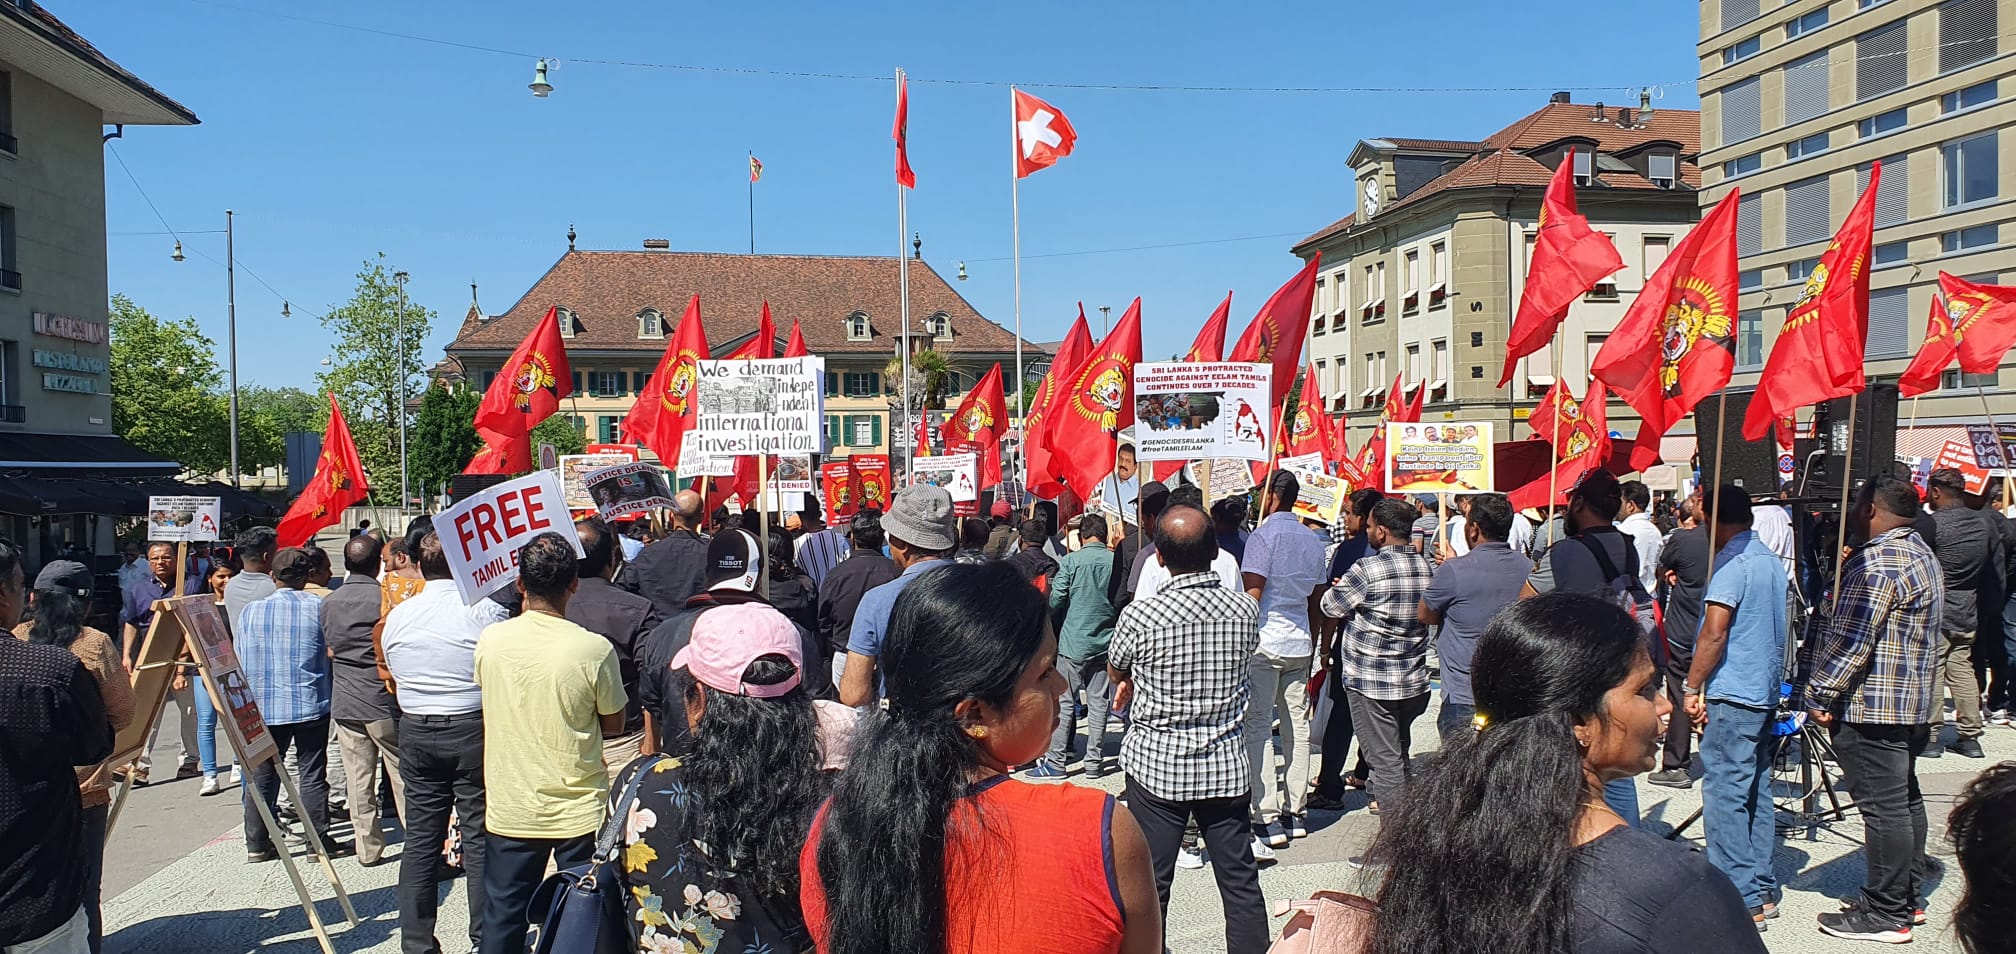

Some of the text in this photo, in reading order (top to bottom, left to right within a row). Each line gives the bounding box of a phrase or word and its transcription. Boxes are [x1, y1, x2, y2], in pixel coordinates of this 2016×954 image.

[698, 358, 804, 378] We demand
[699, 412, 808, 431] international
[698, 433, 815, 453] investigation.
[586, 468, 623, 487] JUSTICE
[617, 478, 632, 487] IS
[604, 503, 644, 520] JUSTICE
[454, 485, 551, 562] FREE
[472, 556, 509, 588] TAMIL
